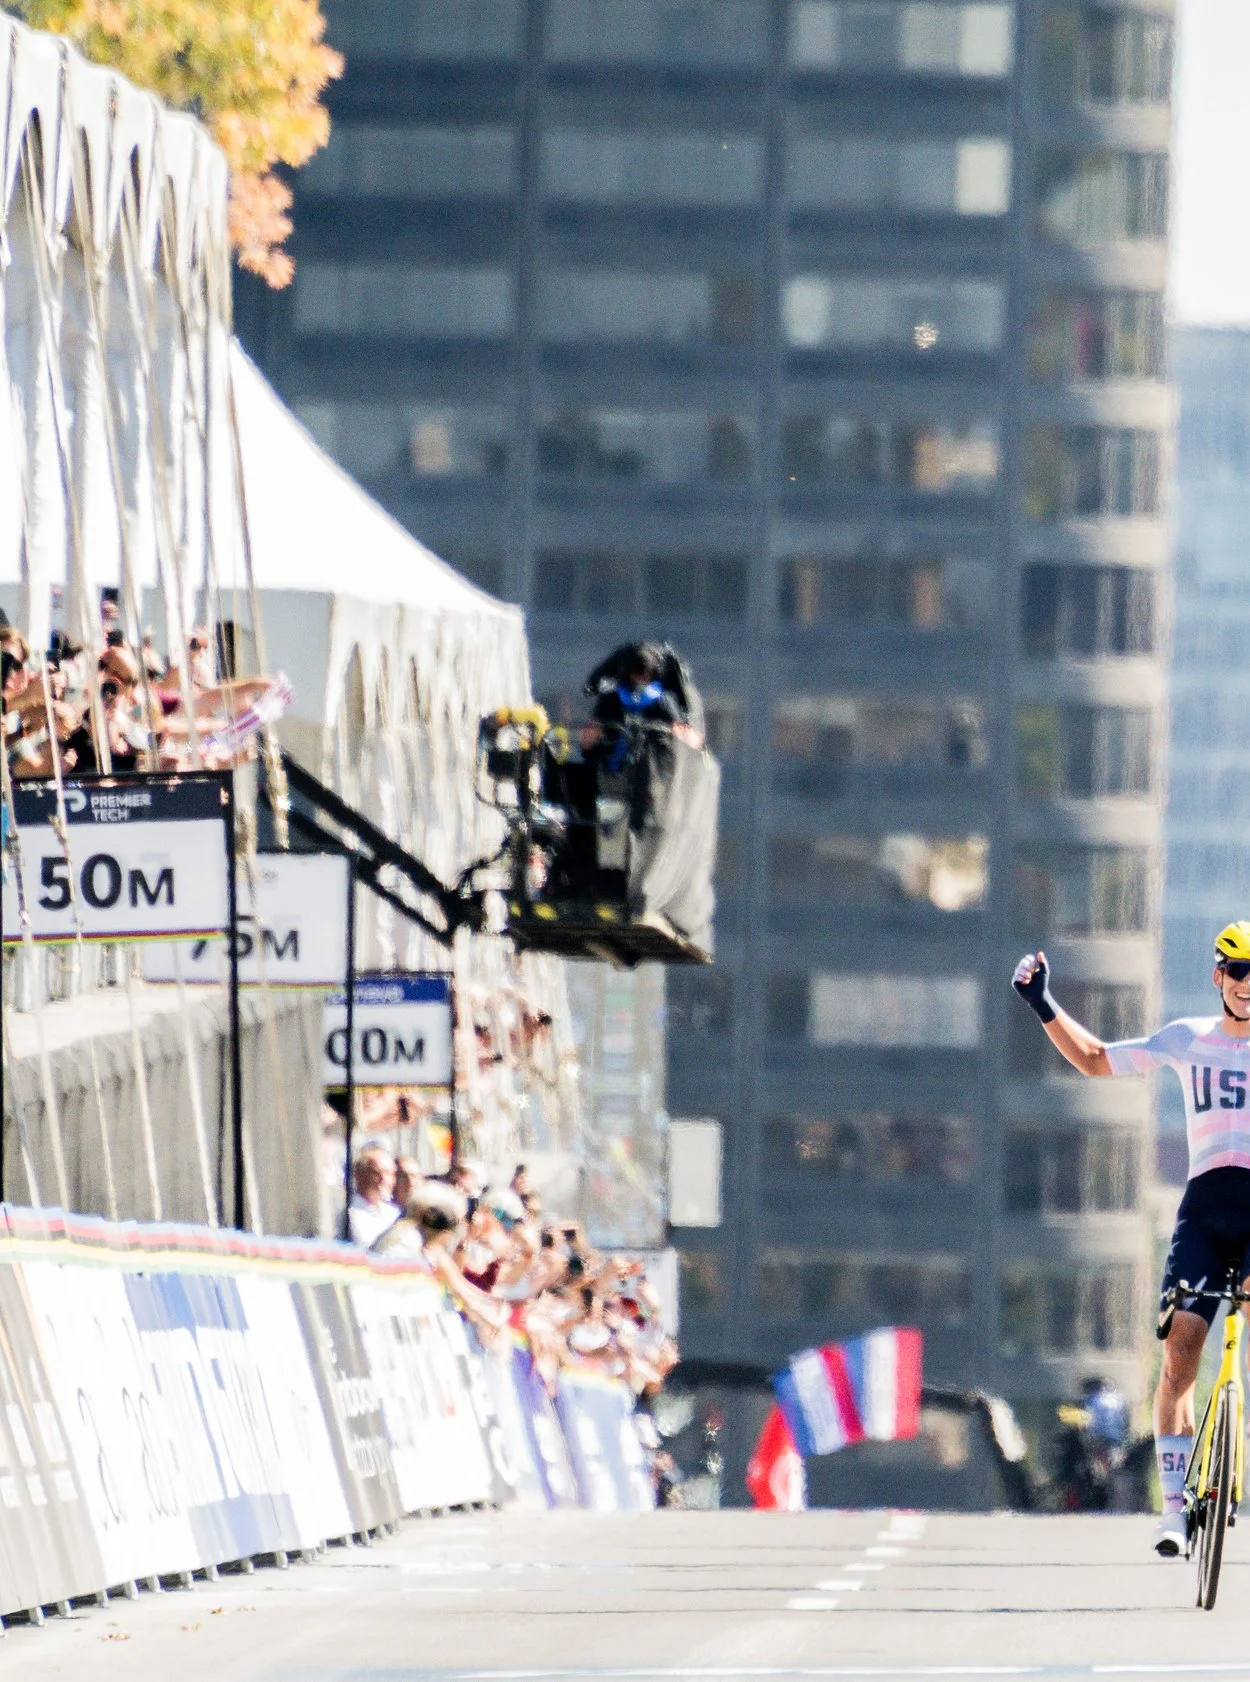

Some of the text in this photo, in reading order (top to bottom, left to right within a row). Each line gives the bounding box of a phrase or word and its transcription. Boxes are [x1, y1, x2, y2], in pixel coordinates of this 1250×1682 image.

[90, 792, 152, 808] PREMIER
[92, 808, 130, 822] TECH
[38, 852, 175, 911] 50M
[324, 1026, 425, 1067] 00M
[1160, 1452, 1186, 1473] SA
